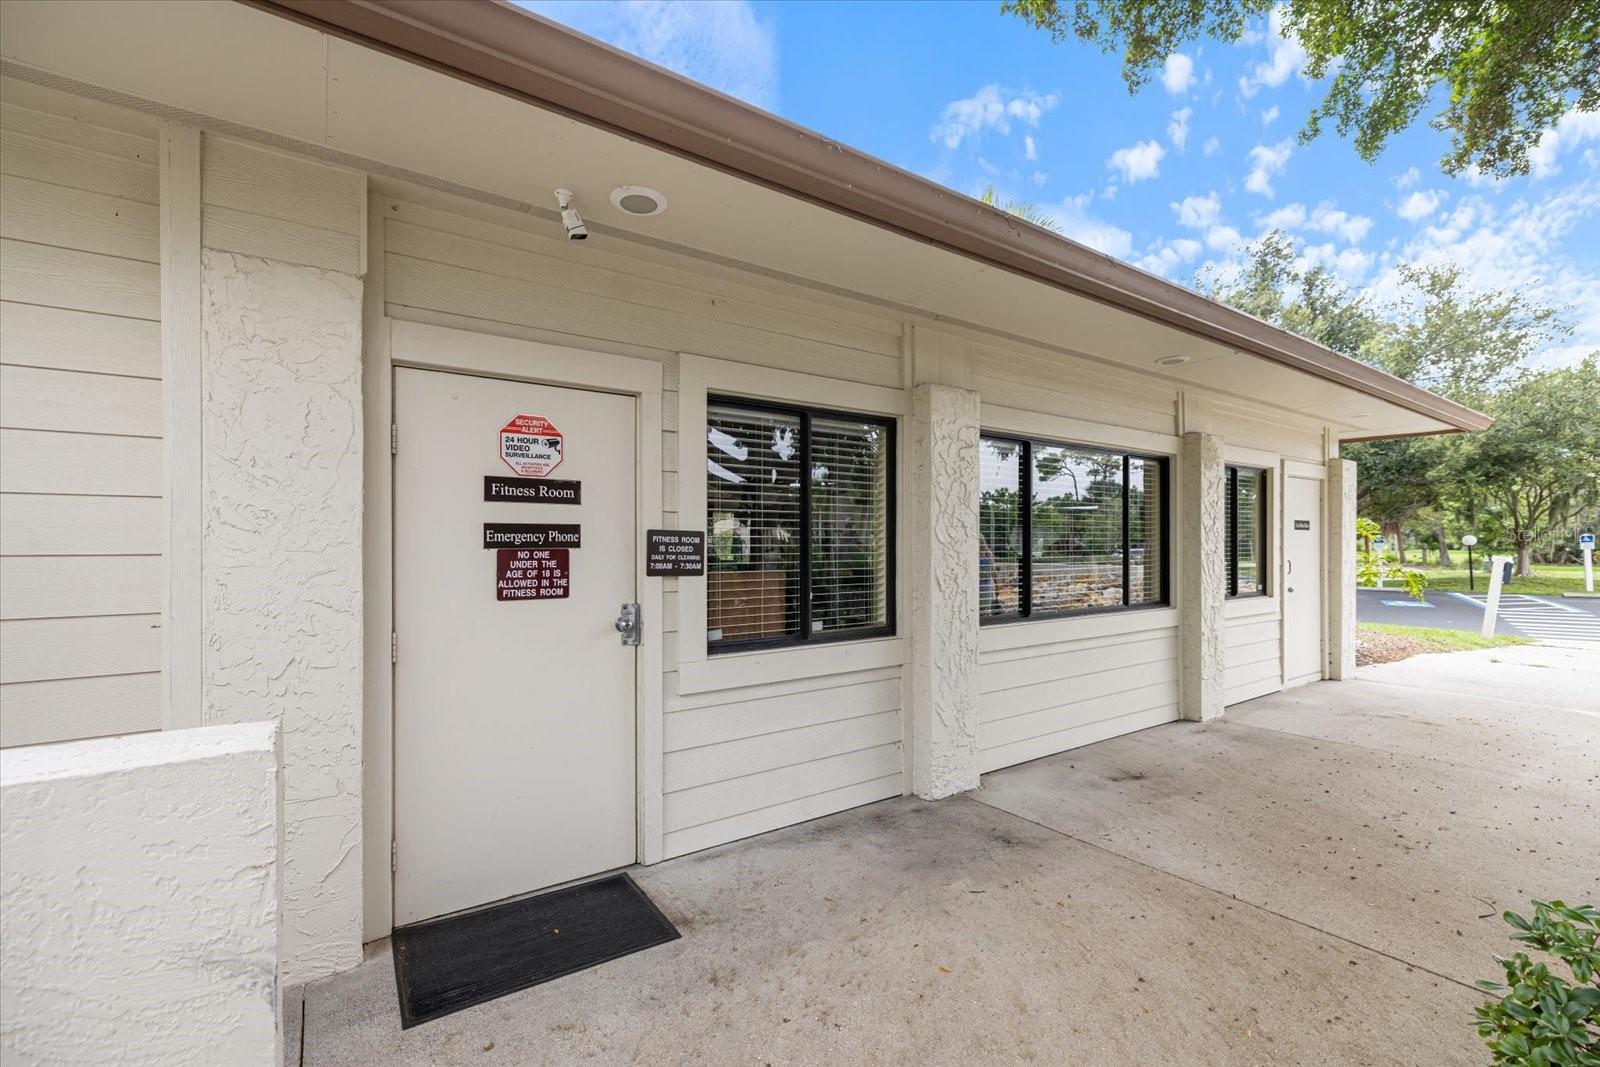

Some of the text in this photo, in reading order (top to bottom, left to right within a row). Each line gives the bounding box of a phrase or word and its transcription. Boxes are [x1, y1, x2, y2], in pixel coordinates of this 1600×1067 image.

[515, 418, 548, 428] SECURITY
[505, 452, 551, 460] SURVEILLANCE
[491, 483, 574, 498] Fitness Room
[486, 530, 579, 544] Emergency Phone
[498, 579, 538, 588] ALLOWED
[503, 589, 536, 597] FITNESS
